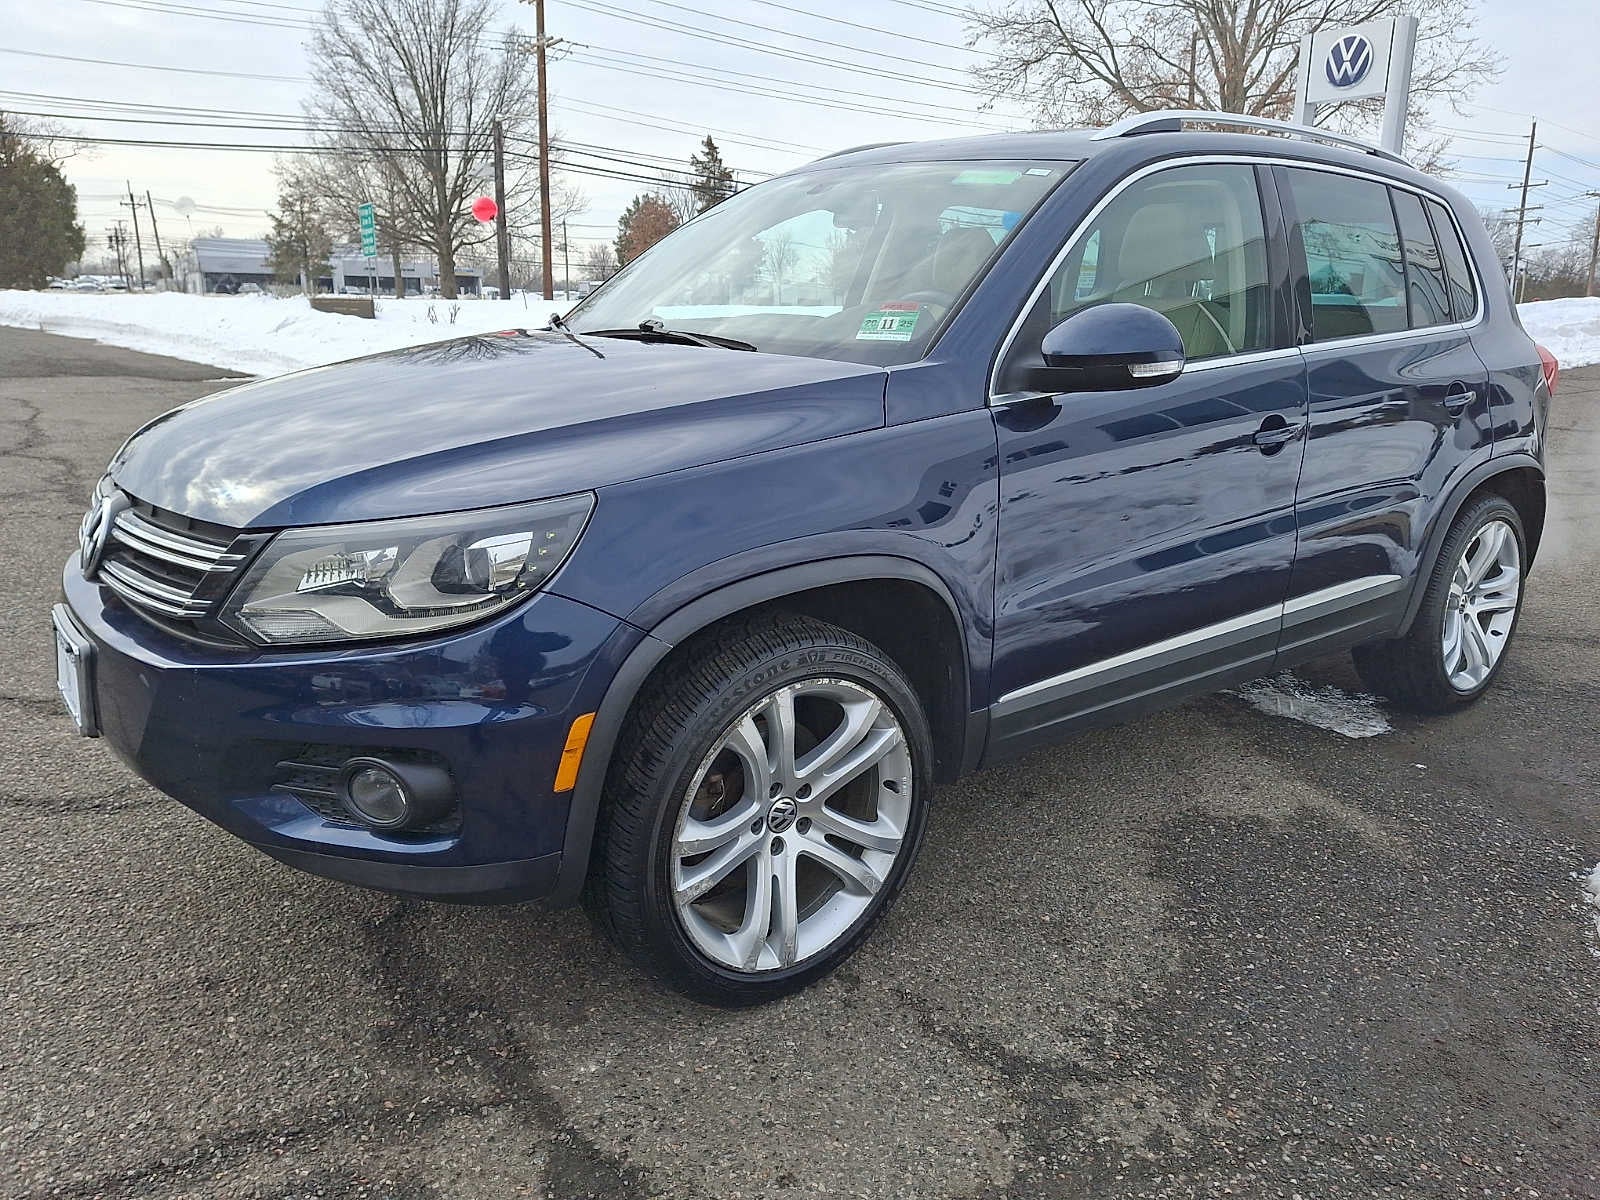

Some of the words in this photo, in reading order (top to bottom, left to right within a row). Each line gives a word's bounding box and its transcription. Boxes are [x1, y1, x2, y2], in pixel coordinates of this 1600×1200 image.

[1325, 34, 1374, 90] VW
[880, 318, 895, 330] 11
[899, 319, 913, 328] 25
